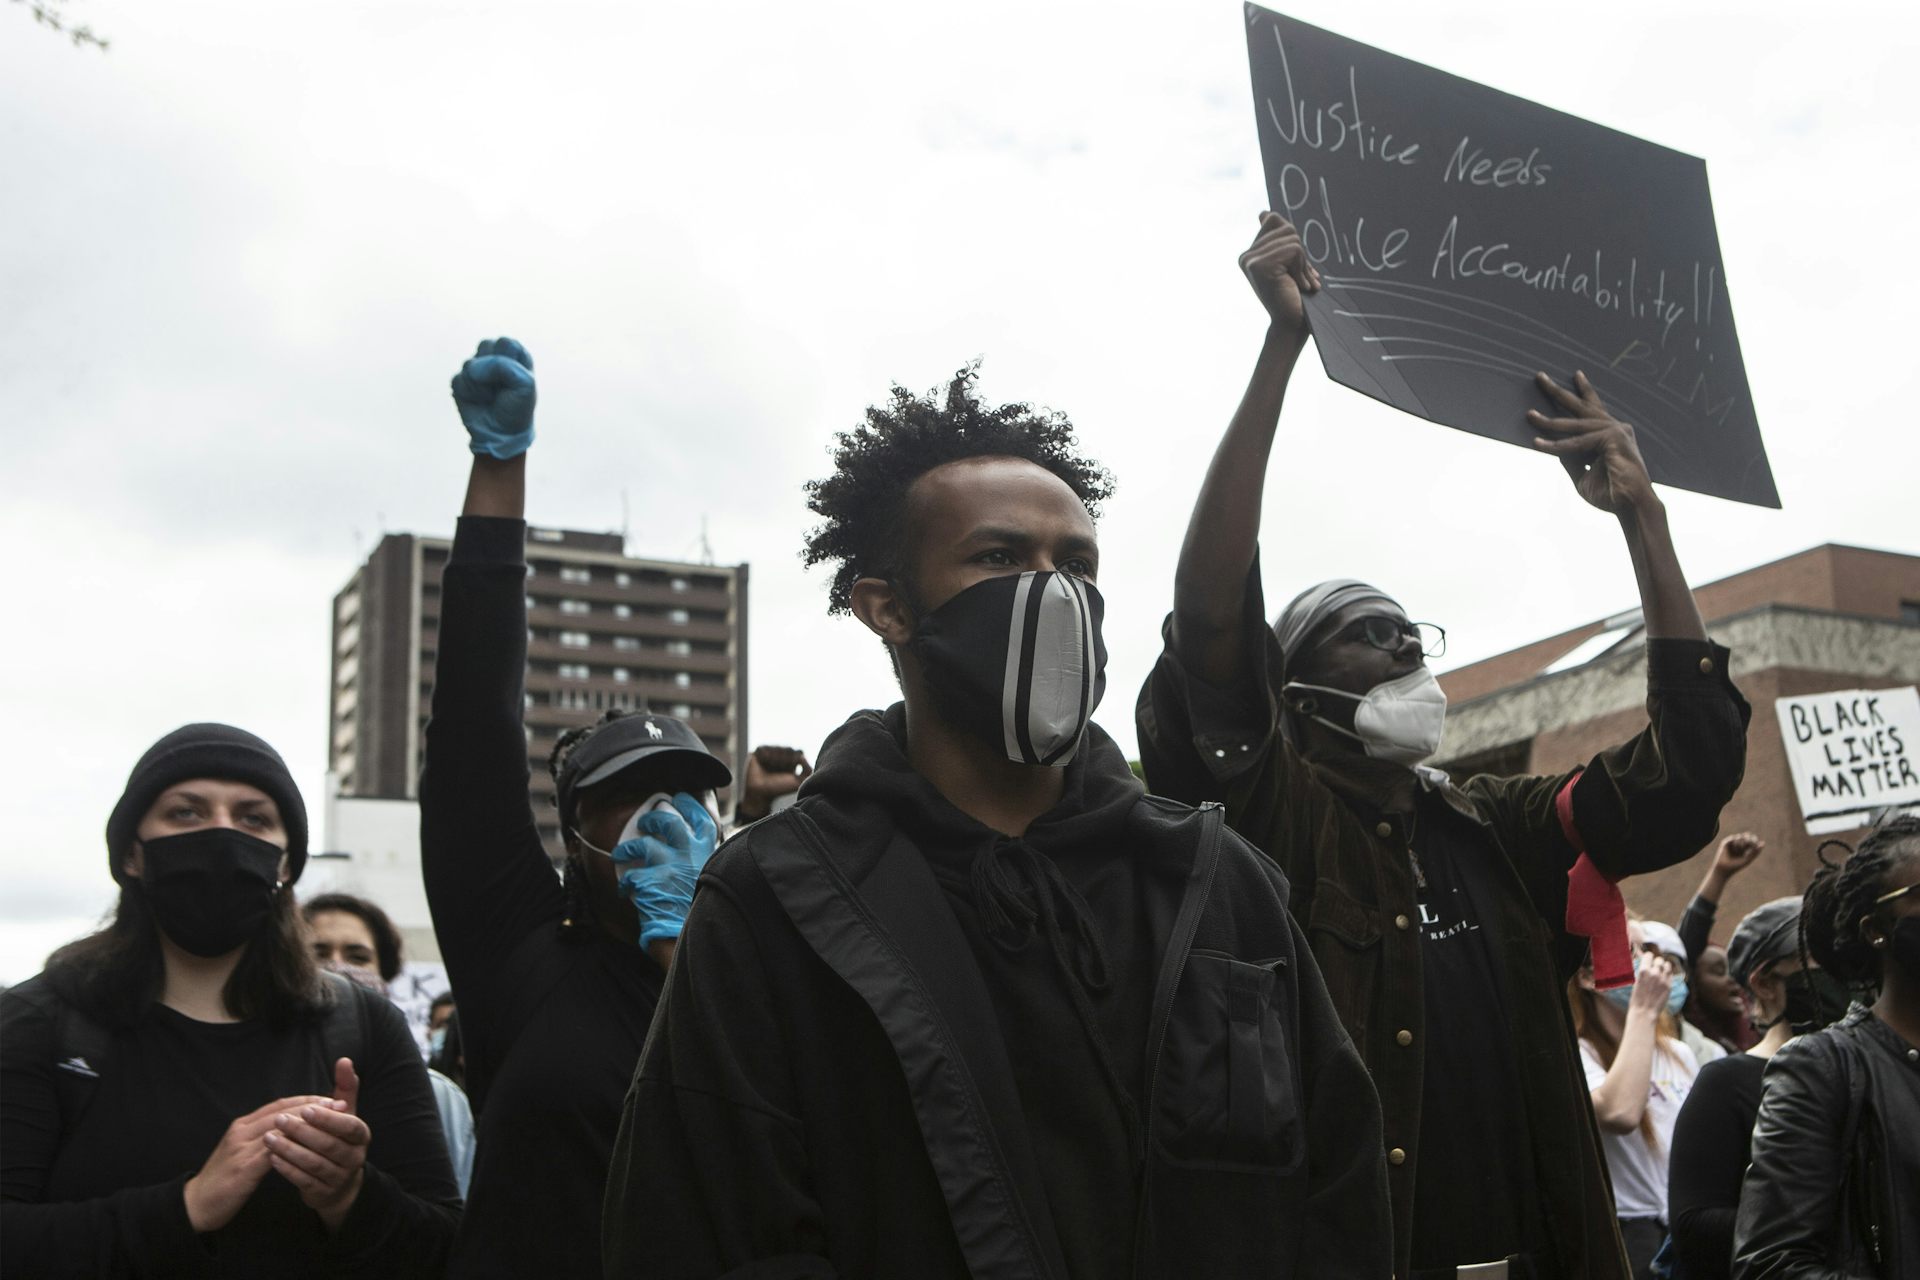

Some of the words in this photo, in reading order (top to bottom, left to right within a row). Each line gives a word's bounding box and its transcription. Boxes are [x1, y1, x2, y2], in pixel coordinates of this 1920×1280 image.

[1267, 23, 1420, 165] Justice
[1443, 135, 1552, 188] Needs
[1280, 163, 1410, 272] Police
[1609, 339, 1736, 427] BLM
[1789, 697, 1885, 743] BLACK
[1823, 726, 1905, 766] LIVES
[1811, 757, 1919, 799] MATTER
